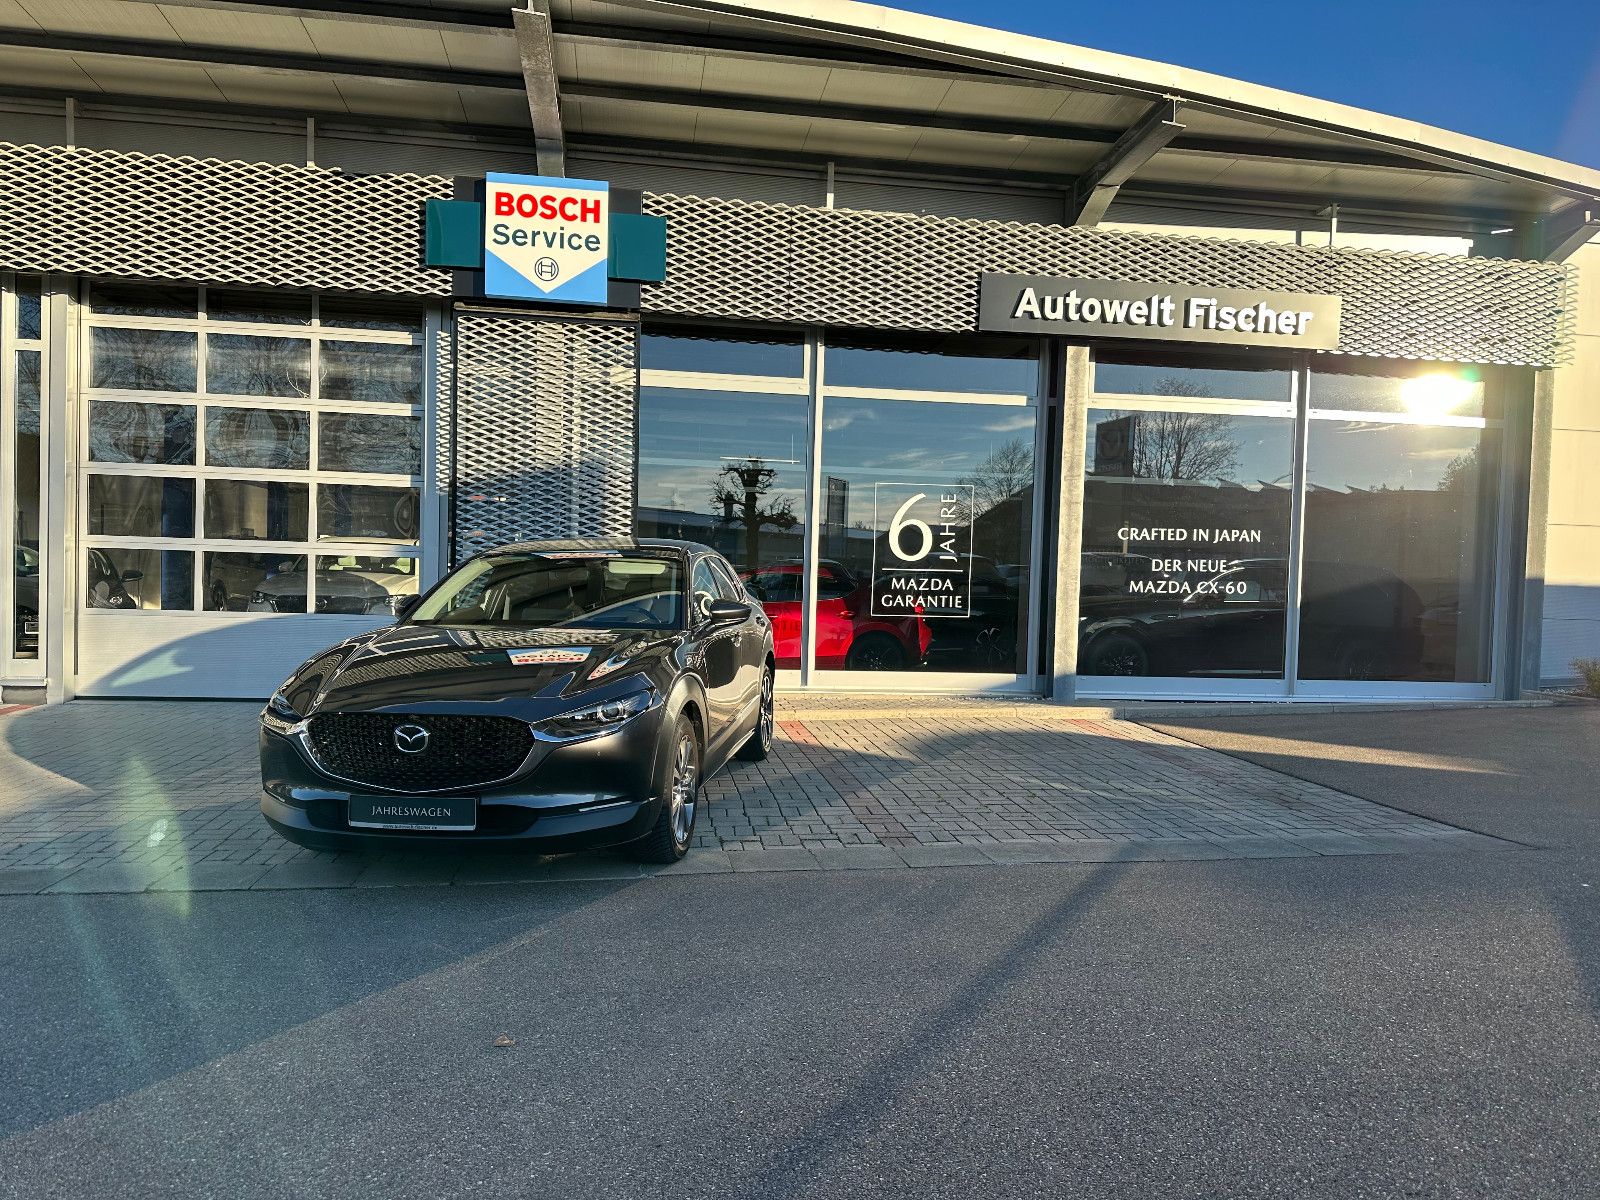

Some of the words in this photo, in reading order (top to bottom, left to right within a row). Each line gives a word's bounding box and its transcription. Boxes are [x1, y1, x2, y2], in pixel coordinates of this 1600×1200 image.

[494, 191, 600, 223] BOSCH
[492, 223, 601, 252] Service
[1011, 287, 1175, 327] Autowelt
[1185, 297, 1313, 336] Fischer
[888, 492, 933, 562] 6
[939, 493, 958, 563] JAHRE
[1117, 527, 1188, 541] CRAFTED
[1193, 528, 1209, 542] IN
[1213, 528, 1262, 544] JAPAN
[1151, 559, 1182, 572] DER
[1187, 559, 1227, 573] NEUE
[891, 577, 954, 591] MAZDA
[1129, 580, 1191, 594] MAZDA
[1196, 581, 1247, 595] CX-60
[881, 594, 963, 608] GARANTIE
[371, 805, 451, 817] JAHRESWAGEN
